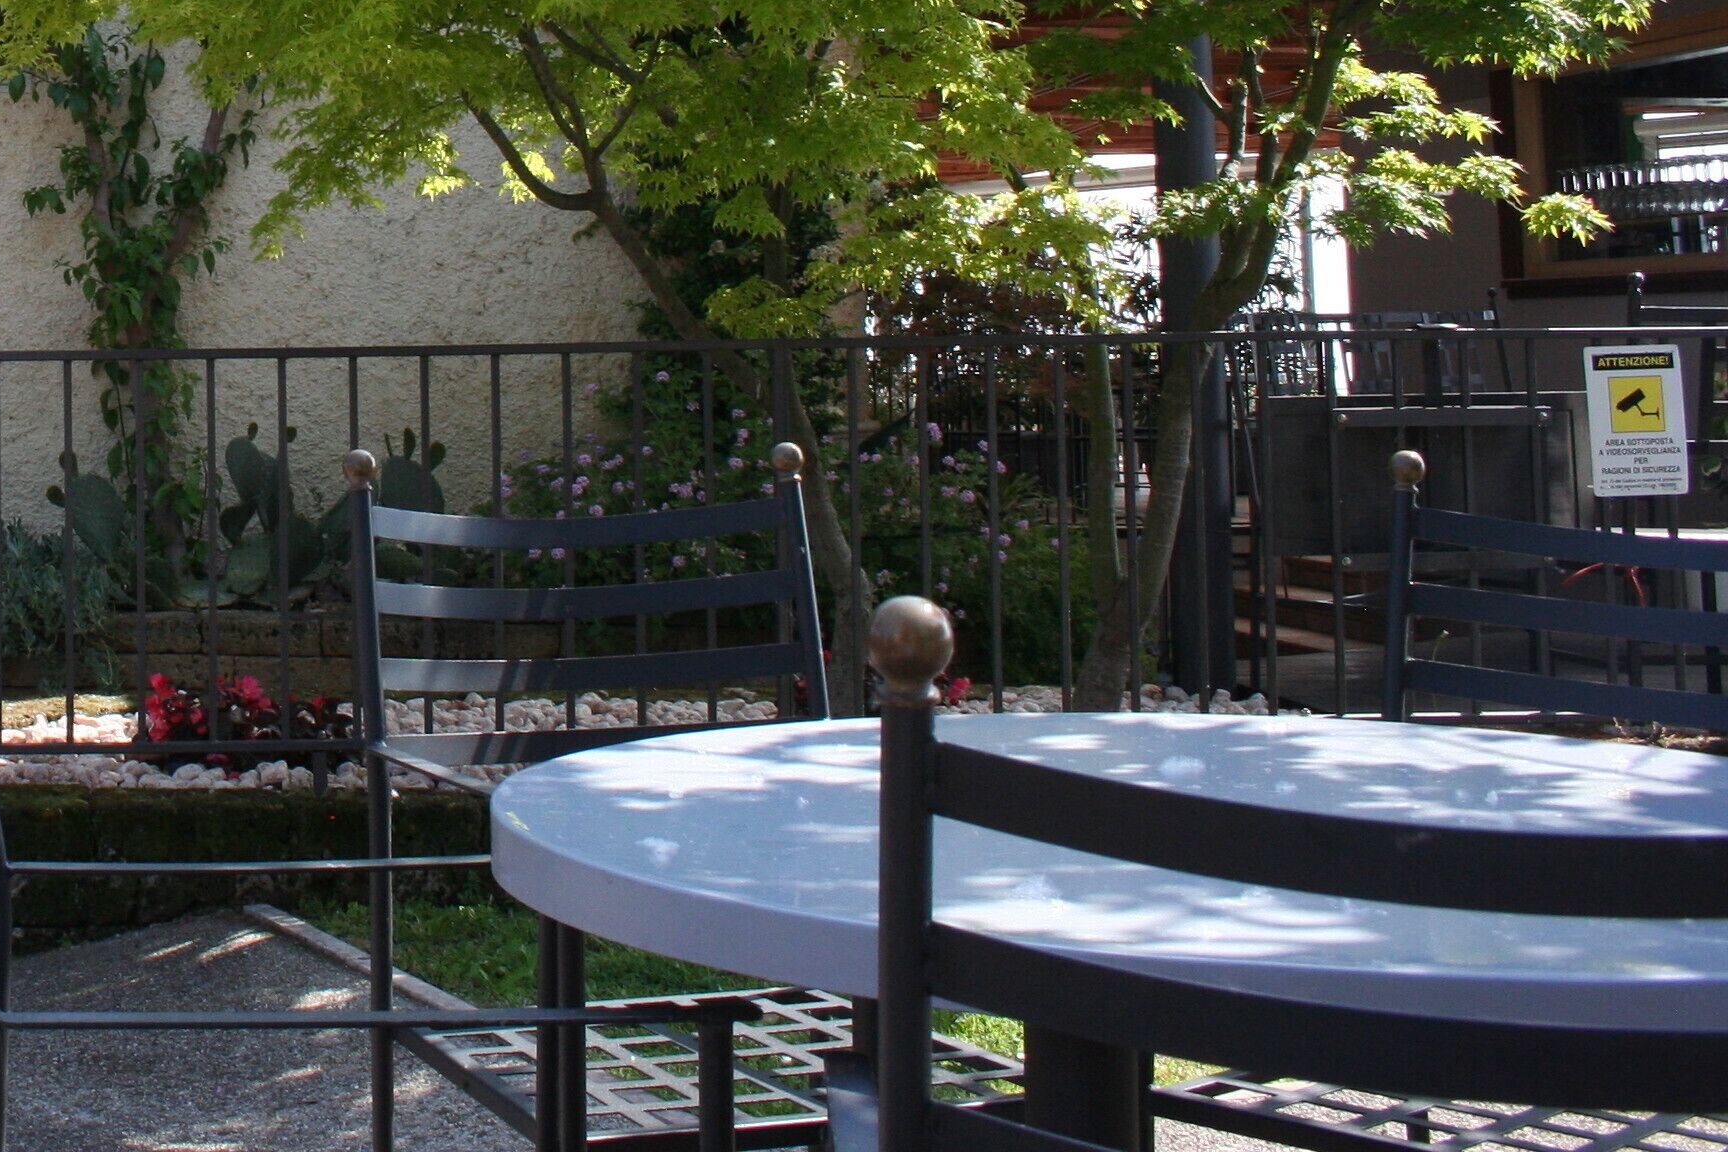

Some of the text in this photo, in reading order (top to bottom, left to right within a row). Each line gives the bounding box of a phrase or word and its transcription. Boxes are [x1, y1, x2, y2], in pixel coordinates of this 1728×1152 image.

[1597, 355, 1670, 367] ATTENZIONE!
[1605, 437, 1674, 446] AREA SOTTOPOSTA
[1606, 446, 1681, 456] VIDEOSORVEGLIANZA
[1601, 467, 1631, 475] RAGIONI
[1642, 465, 1680, 474] SICUREZZA
